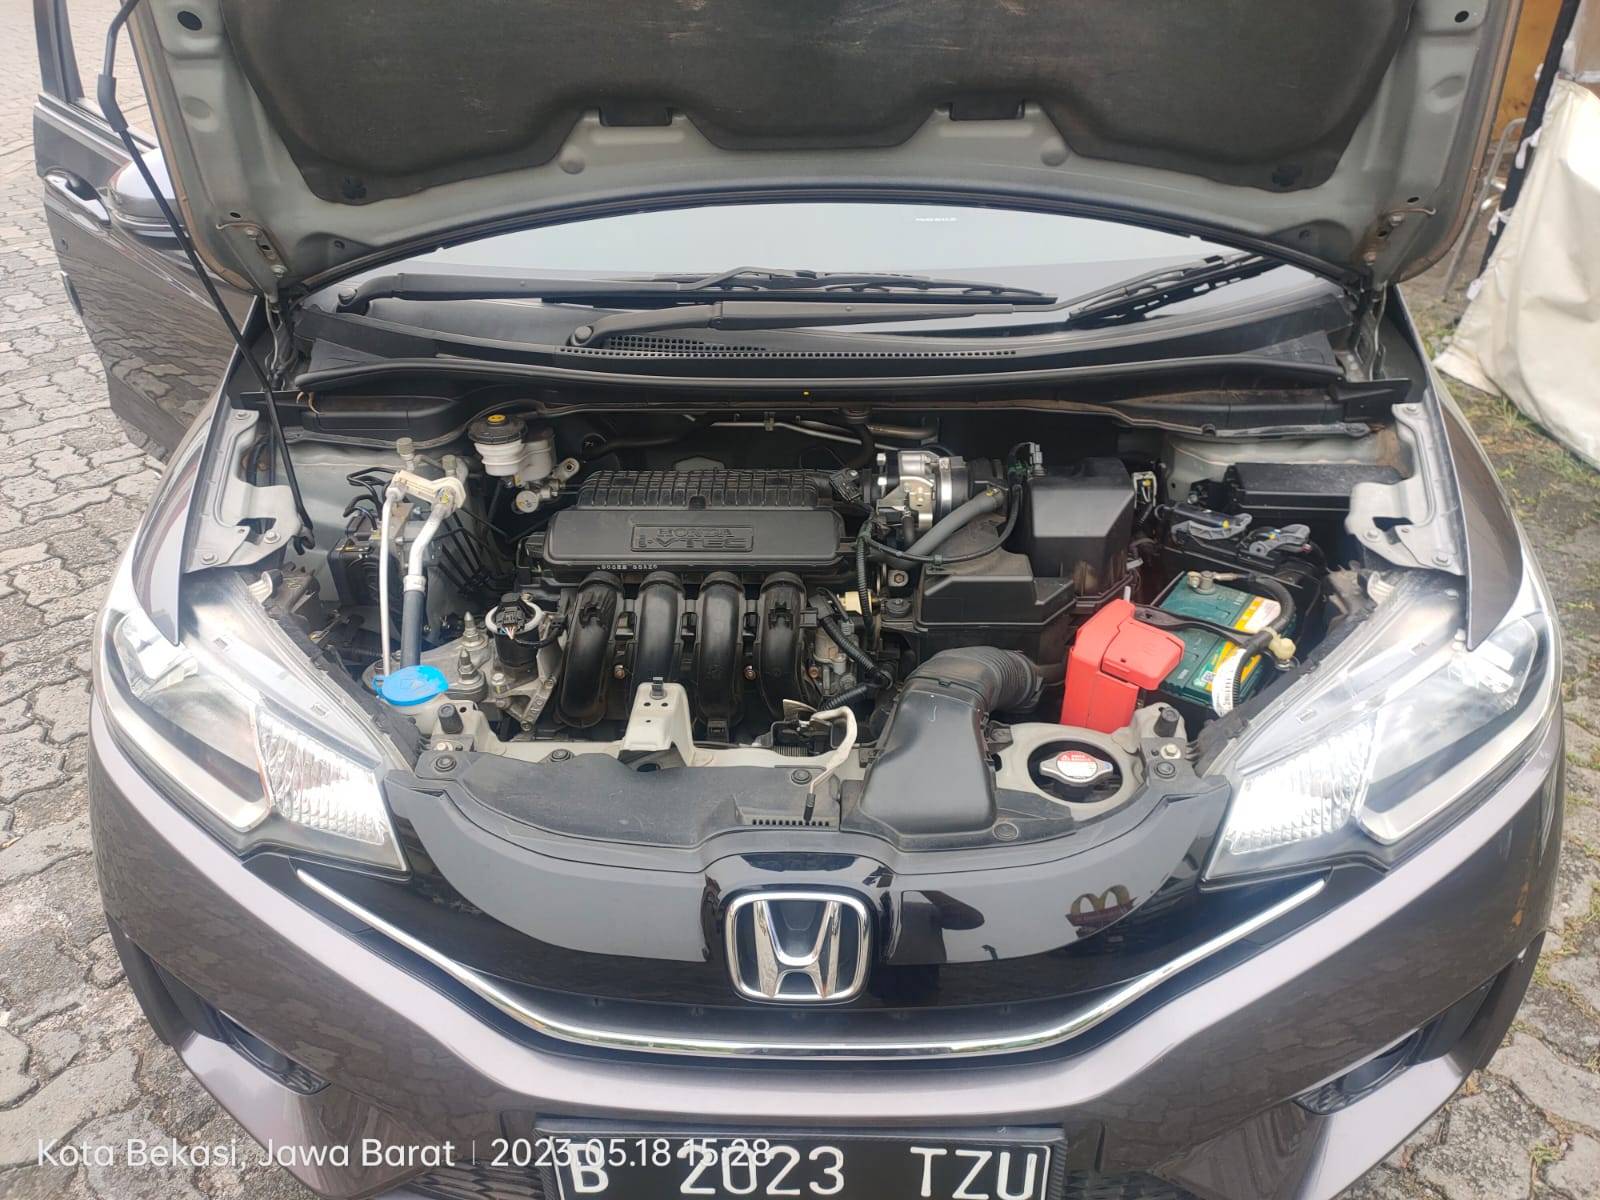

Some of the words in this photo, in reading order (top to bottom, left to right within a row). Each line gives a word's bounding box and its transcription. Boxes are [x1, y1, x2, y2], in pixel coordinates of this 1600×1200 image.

[567, 1142, 609, 1194] B
[676, 1144, 845, 1196] 2023
[910, 1146, 1038, 1200] TZU
